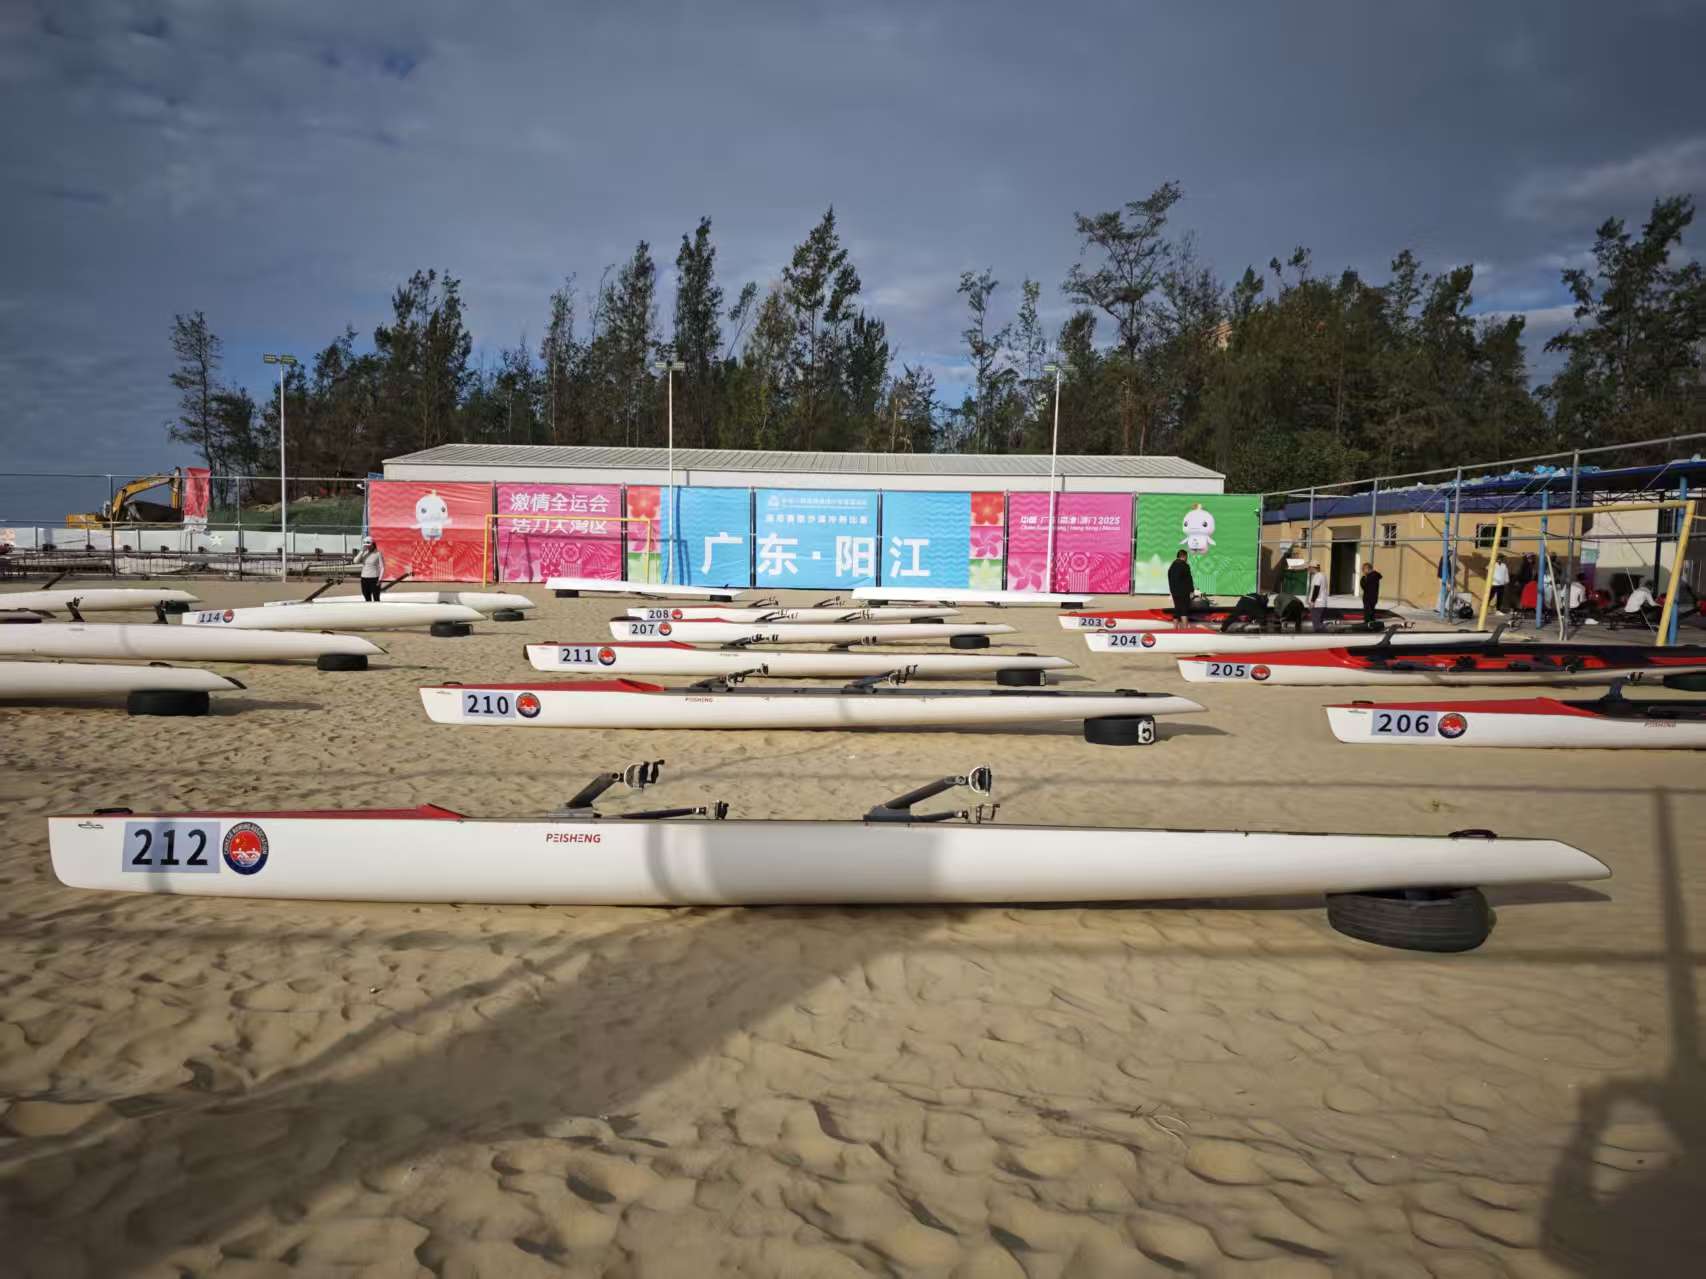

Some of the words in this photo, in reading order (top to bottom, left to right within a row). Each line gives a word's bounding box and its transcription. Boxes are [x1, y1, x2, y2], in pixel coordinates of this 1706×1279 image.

[510, 492, 610, 512] 激情全运会
[700, 531, 930, 578] 广东·阳江
[199, 612, 220, 622] 114
[649, 610, 669, 619] 208
[1081, 618, 1102, 627] 203
[631, 624, 655, 635] 207
[1111, 635, 1137, 647] 204
[562, 649, 593, 662] 211
[1210, 663, 1245, 677] 205
[468, 694, 509, 714] 210
[1378, 713, 1429, 734] 206
[546, 833, 601, 843] PEISHENG
[132, 829, 208, 865] 212
